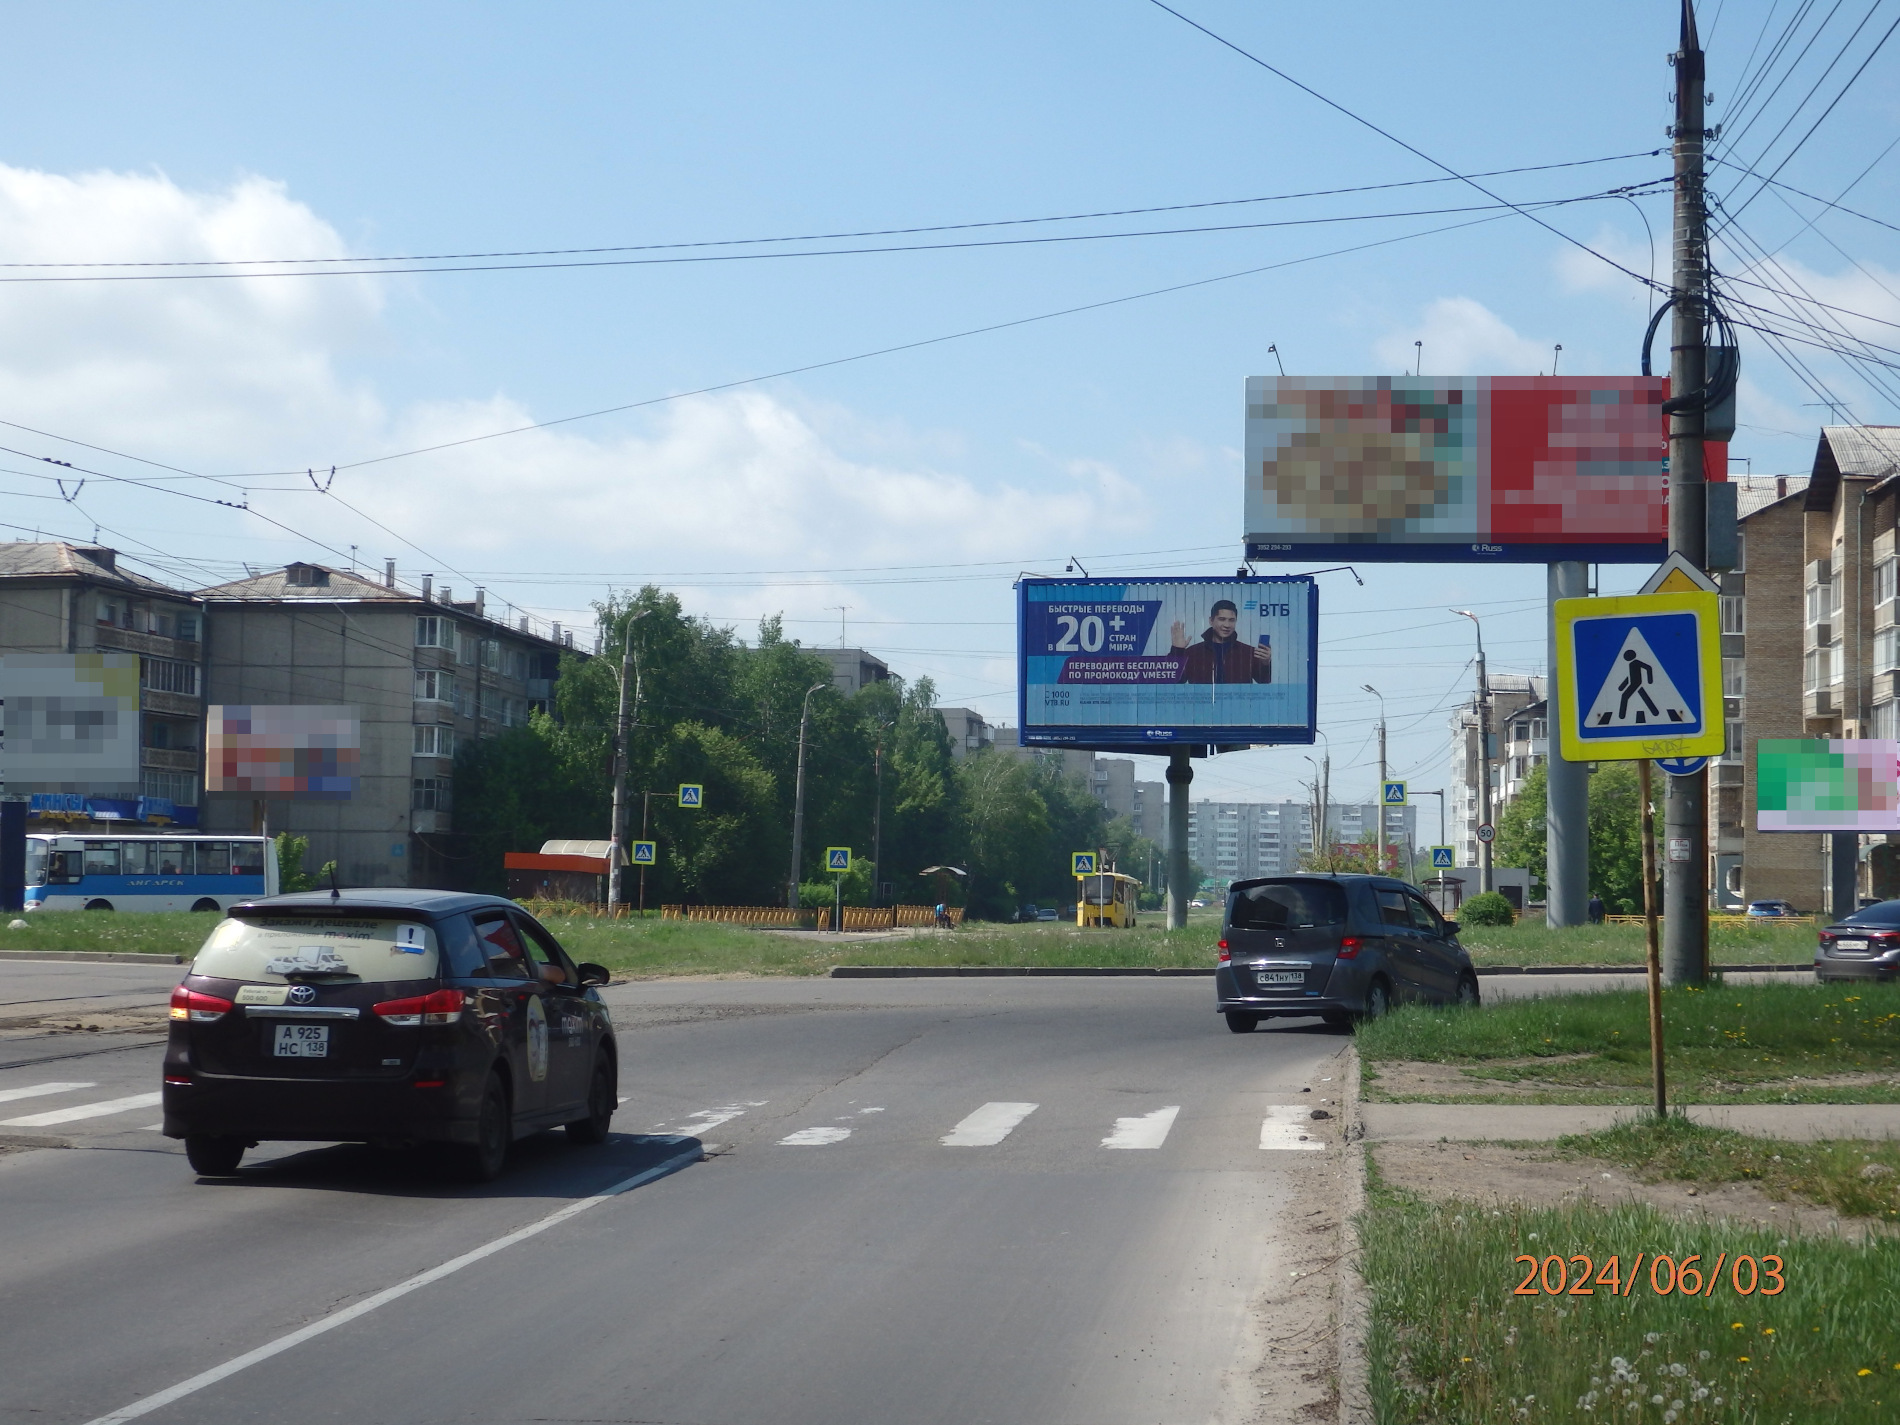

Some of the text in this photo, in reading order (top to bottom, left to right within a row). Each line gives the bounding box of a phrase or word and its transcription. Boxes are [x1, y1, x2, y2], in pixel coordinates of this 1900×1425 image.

[1481, 543, 1503, 552] Russ
[1048, 604, 1145, 614] БЫСТРЫЕ ПЕРЕВОДЫ
[1259, 603, 1290, 617] ВТБ
[1109, 634, 1137, 642] СТРАН
[1109, 643, 1134, 651] МИРА
[1069, 662, 1179, 670] ПЕРЕВОДИТЕ БЕСПЛАТНО
[1069, 671, 1176, 680] ПО ПРОМОКОДУ VMESTE
[1052, 690, 1070, 699] 1000
[1480, 829, 1492, 837] 50
[260, 918, 312, 928] Закажи
[1260, 973, 1288, 982] С841НУ
[283, 1026, 322, 1040] А 925
[279, 1042, 324, 1055] НС 138
